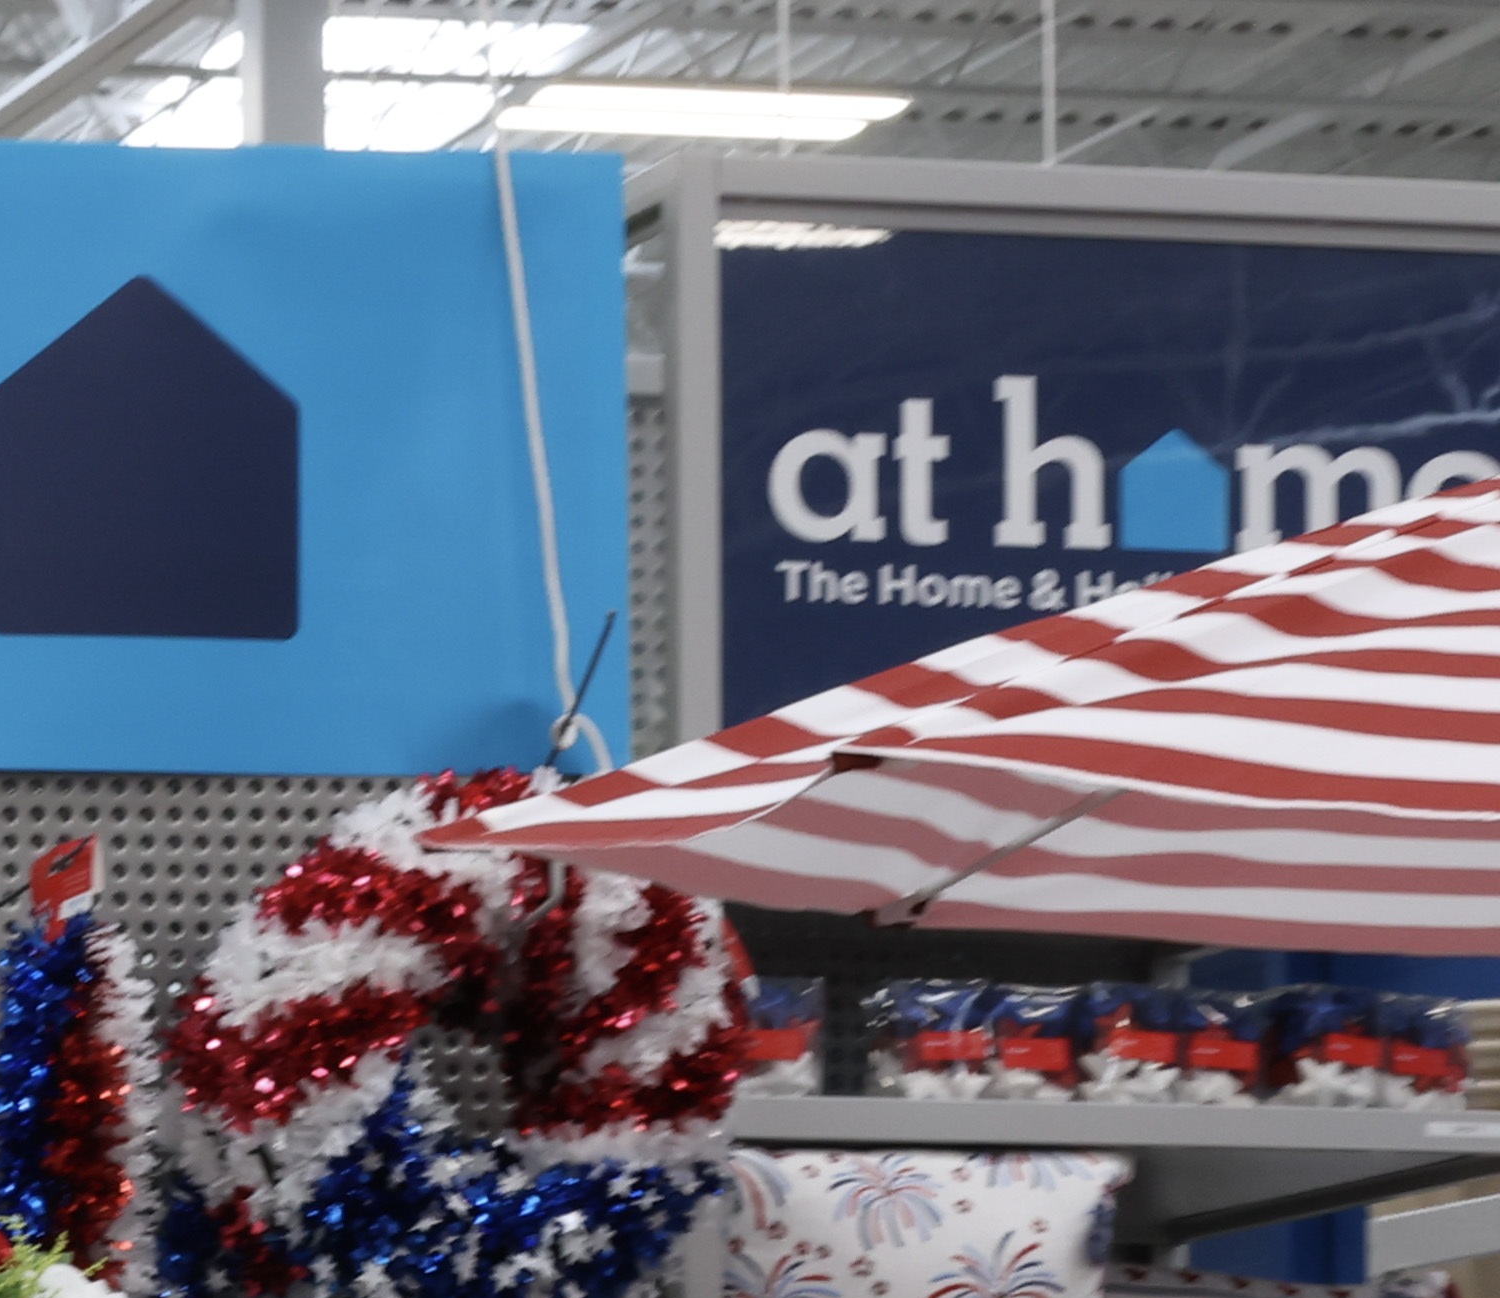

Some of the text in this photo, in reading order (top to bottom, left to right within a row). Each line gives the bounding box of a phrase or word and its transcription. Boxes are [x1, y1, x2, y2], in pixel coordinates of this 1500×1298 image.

[767, 398, 949, 547] at
[775, 560, 869, 603] The
[876, 563, 1022, 608] Home
[1028, 568, 1068, 611] &
